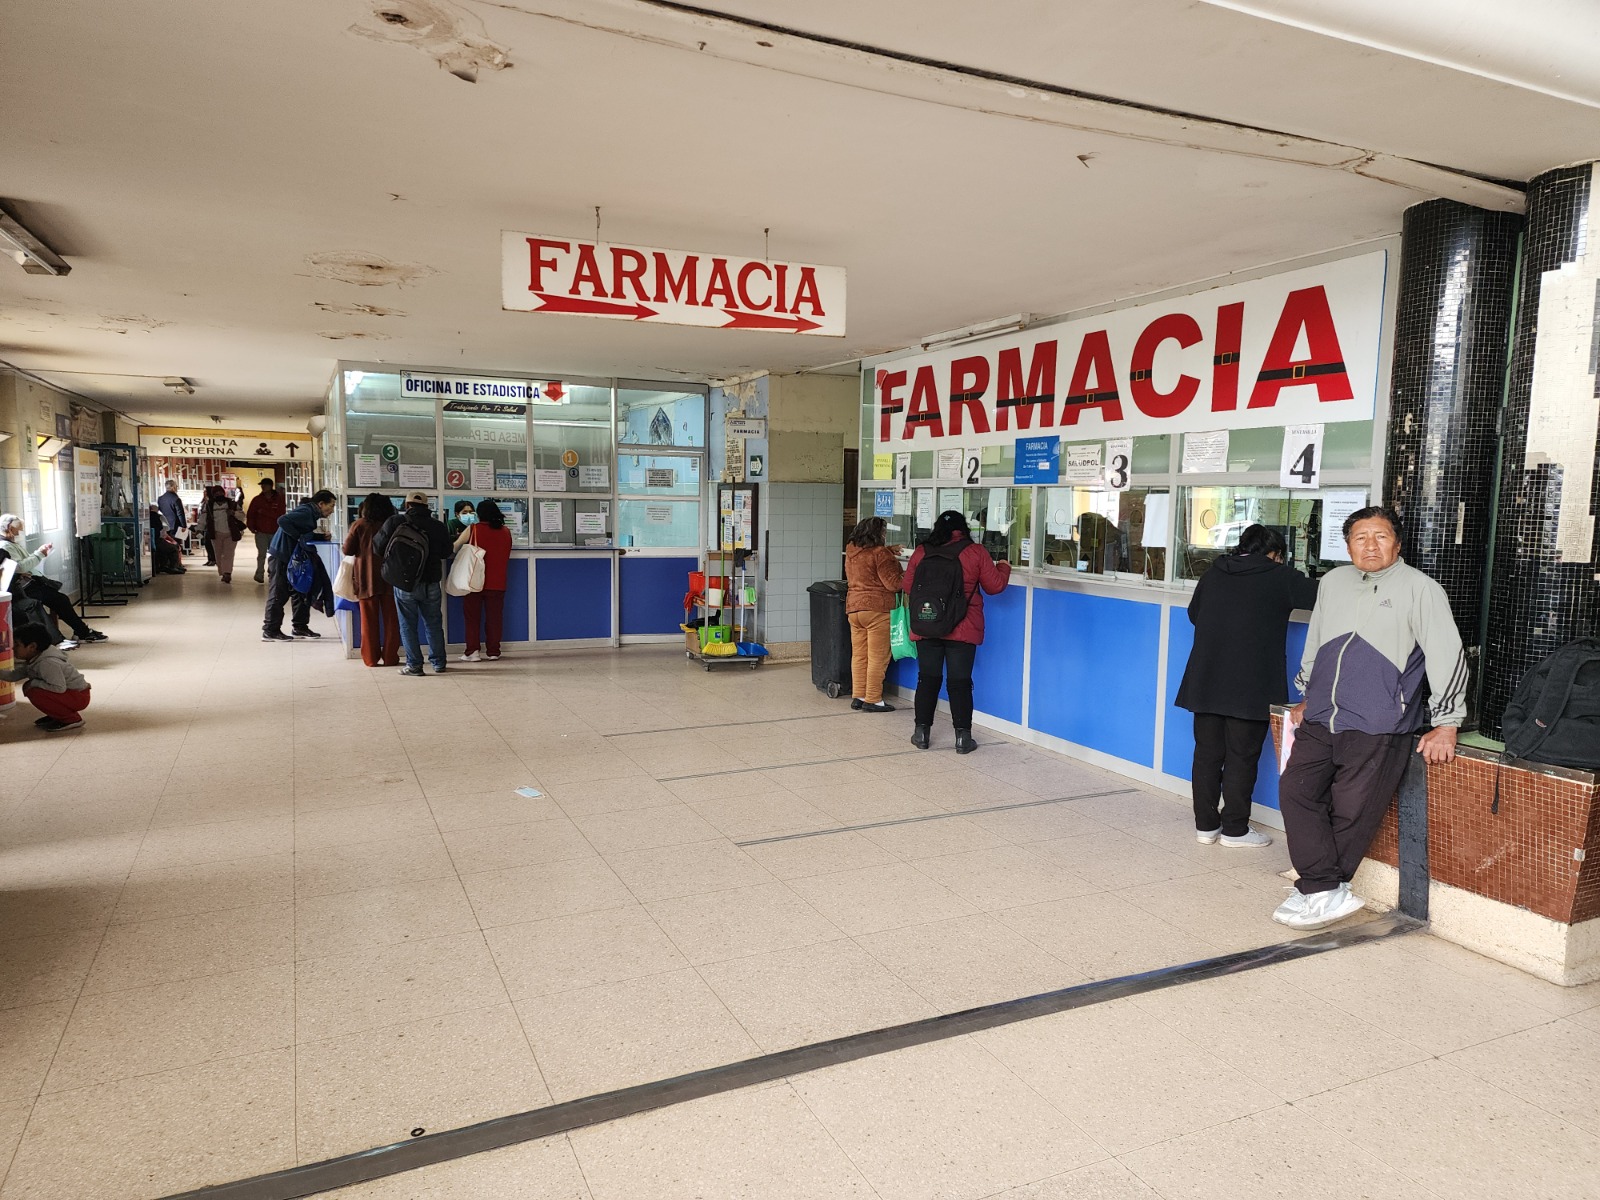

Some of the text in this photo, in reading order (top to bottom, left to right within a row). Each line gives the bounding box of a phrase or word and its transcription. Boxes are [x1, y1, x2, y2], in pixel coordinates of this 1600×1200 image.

[526, 237, 825, 317] FARMACIA
[880, 284, 1354, 442] FARMACIA
[406, 378, 540, 399] OFICINA DE ESTADISTICA
[450, 402, 479, 412] Trabajando
[502, 405, 519, 413] Salud
[162, 437, 238, 447] CONSULTA
[1025, 441, 1048, 450] FARMACIA
[170, 446, 236, 455] EXTERNA
[386, 446, 395, 458] 3
[567, 453, 573, 463] 1
[966, 456, 979, 484] 2
[1110, 454, 1128, 489] 3
[1289, 443, 1316, 484] 4
[451, 473, 459, 484] 2
[900, 464, 907, 489] 1
